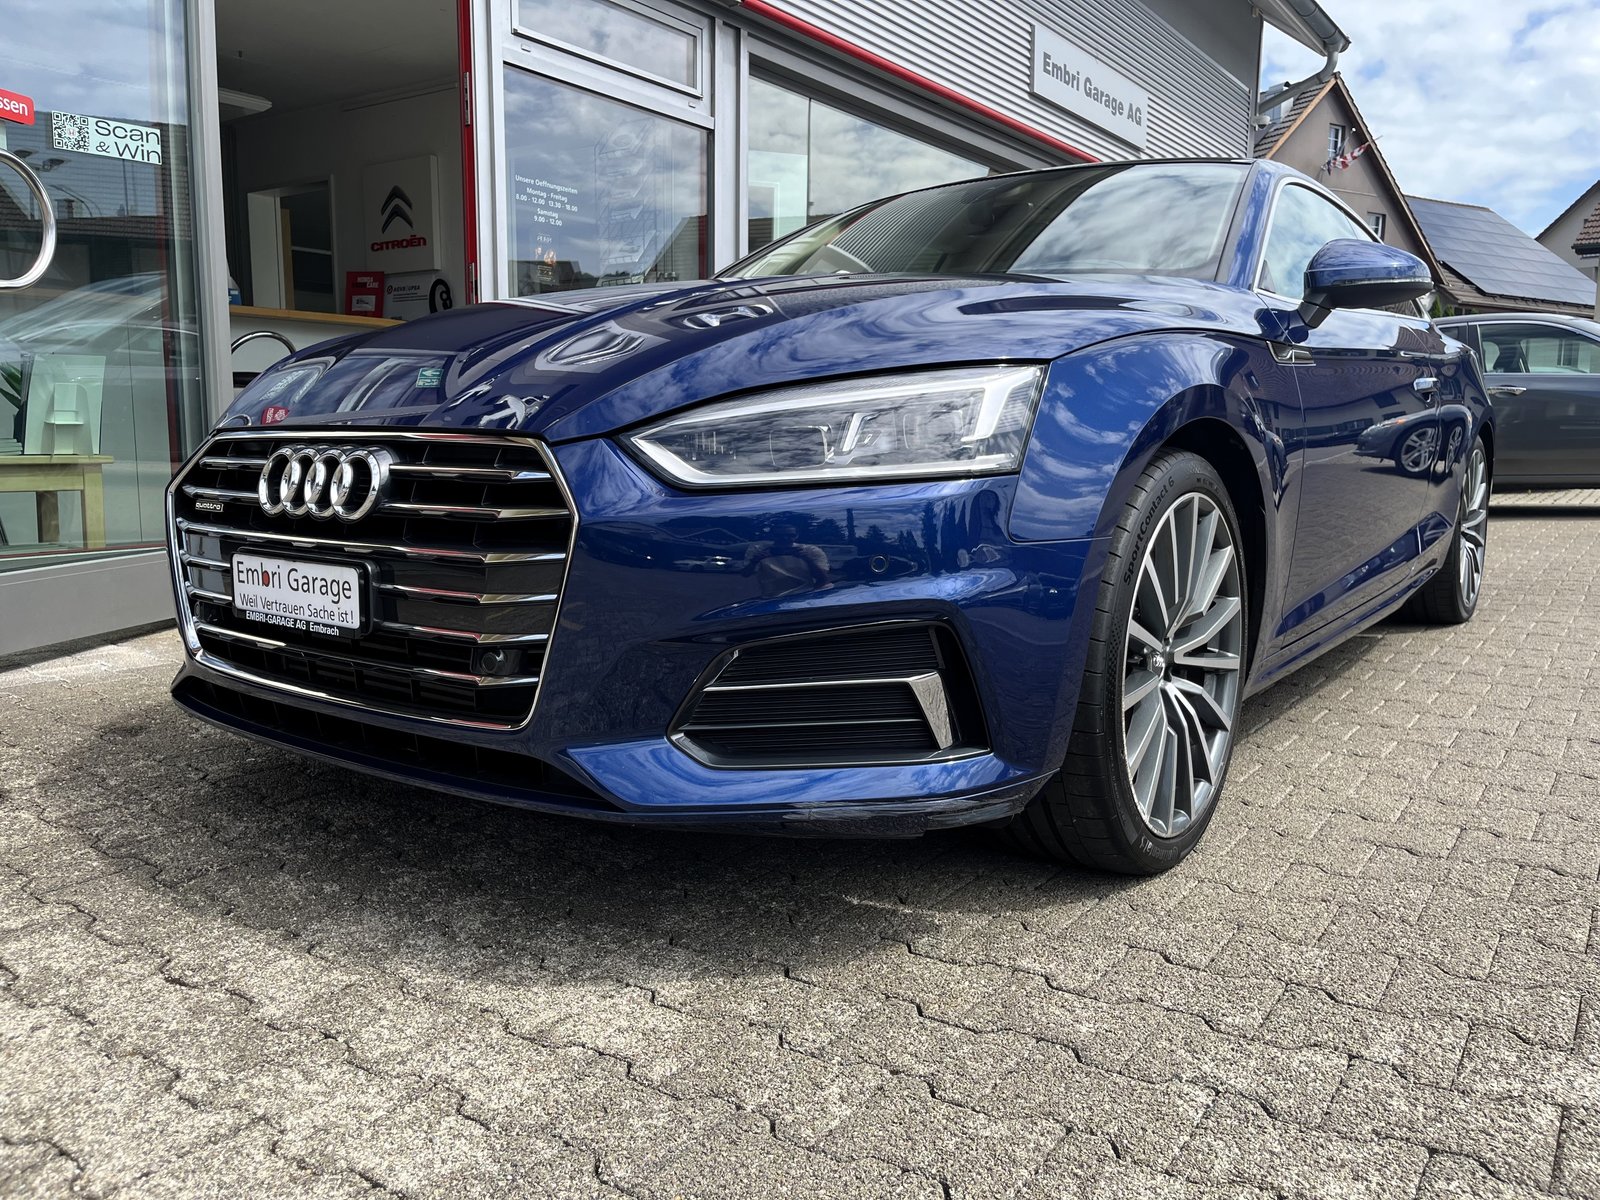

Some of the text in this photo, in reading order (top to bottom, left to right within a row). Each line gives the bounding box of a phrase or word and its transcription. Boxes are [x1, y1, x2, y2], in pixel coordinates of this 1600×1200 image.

[1042, 51, 1142, 127] Embri Garage AG
[94, 120, 161, 145] Scan
[95, 141, 161, 164] & Win
[515, 174, 578, 195] Unsere Oeffnungszeiten
[526, 187, 547, 198] Montag
[550, 192, 568, 203] Freitag
[515, 193, 528, 202] 8.00
[531, 197, 546, 205] 12.00
[548, 200, 562, 208] 13.30
[565, 204, 578, 212] 18.00
[537, 208, 559, 219] Samstag
[533, 215, 546, 223] 9.00
[549, 218, 563, 226] 12.00
[370, 234, 427, 252] CITROËN
[195, 502, 221, 510] quattro
[1123, 476, 1175, 586] SportContact 6
[236, 560, 352, 604] Embri Garage
[239, 592, 258, 608] Weil
[259, 596, 305, 616] Vertrauen
[307, 603, 335, 621] Sache
[245, 610, 340, 636] EMBRI-GARAGE AG Embrach
